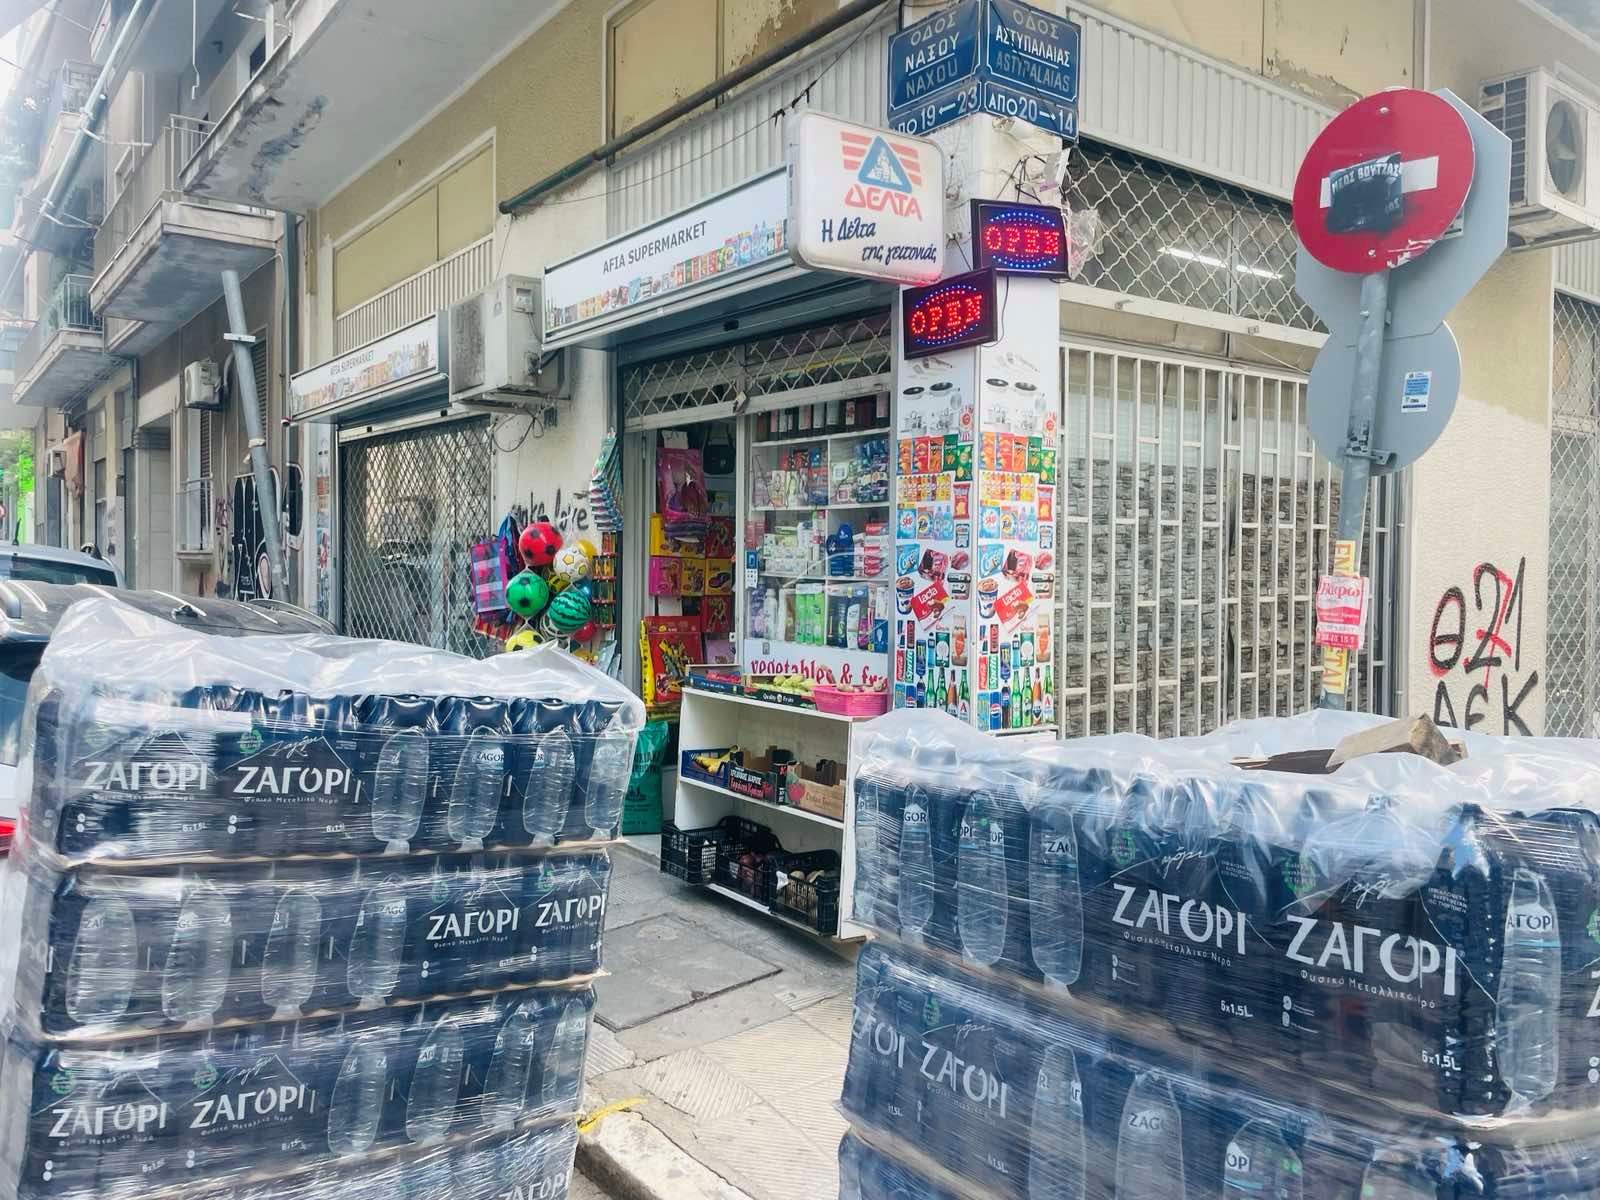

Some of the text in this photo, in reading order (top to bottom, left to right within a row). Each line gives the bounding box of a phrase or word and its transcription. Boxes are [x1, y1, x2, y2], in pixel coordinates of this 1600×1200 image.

[910, 11, 958, 46] ΟΔΟΣ
[1012, 9, 1060, 40] ΟΔΟΣ
[905, 32, 960, 73] ΝΑΞΟΥ
[995, 24, 1071, 68] ΑΣΤΥΠΑΛΑΙΑΣ
[905, 57, 959, 98] NAXOU
[996, 52, 1071, 93] ASTYPALAIAS
[892, 86, 979, 135] ΠΟ 19 23
[988, 93, 1075, 134] ΑΠΟ 20 14
[844, 183, 923, 222] ΔΕΛΤΑ
[602, 220, 707, 275] AFIA SUPERMARKET
[821, 216, 877, 243] Η Δέλτα
[985, 226, 1060, 256] OPEN
[862, 244, 937, 266] της γειτονιάς
[911, 294, 984, 335] OPEN
[554, 487, 589, 531] love
[83, 762, 208, 791] ΖΑΓΟΡΙ
[232, 766, 351, 795] ΖΑΓΟΡΙ
[425, 906, 520, 941] ΖΑΓΟΡΙ
[535, 893, 605, 928] ΖΑΓΟΡΙ
[1112, 883, 1247, 956] ΖΑΓΟΡΙ
[1285, 914, 1457, 997] ΖΑΓΟΡΙ
[1220, 999, 1254, 1018] 6x1.5L
[920, 1040, 1008, 1119] ΖΑΓΟΡΙ
[1421, 1050, 1462, 1071] 6x1.5L
[49, 1102, 167, 1137] ΖΑΓΟΡΙ
[190, 1084, 305, 1129] ΖΑΓΟΡΙ
